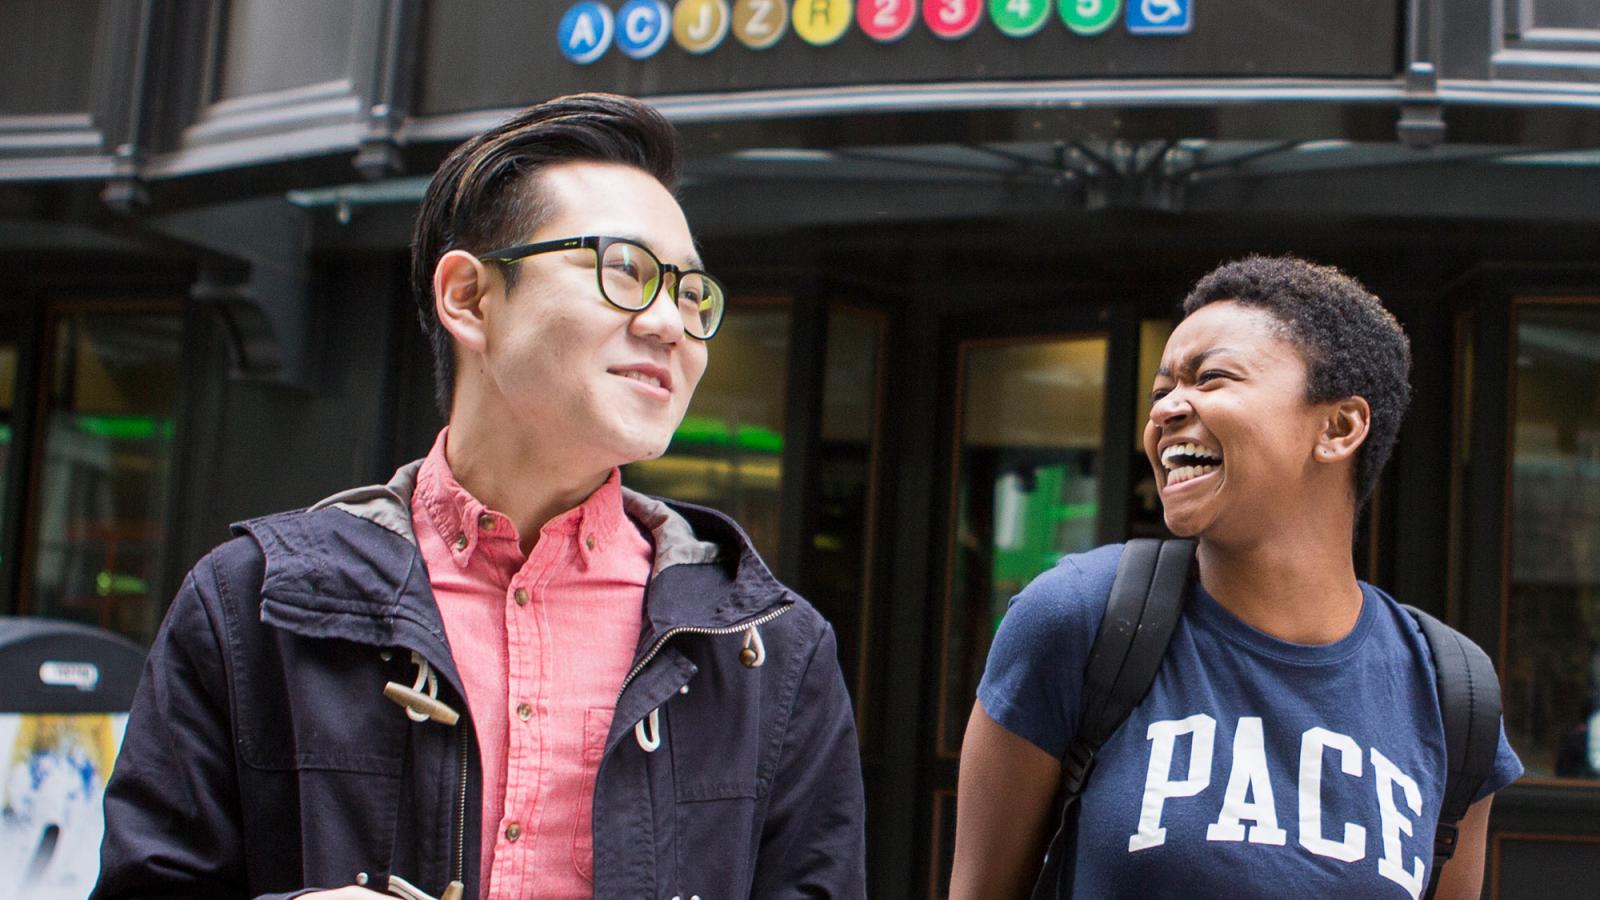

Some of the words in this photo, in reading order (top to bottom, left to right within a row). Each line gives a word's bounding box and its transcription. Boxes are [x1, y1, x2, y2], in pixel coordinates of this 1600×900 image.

[568, 12, 597, 48] A
[625, 6, 654, 43] C
[687, 3, 713, 40] J
[745, 0, 773, 34] Z
[873, 0, 898, 26] 2
[938, 0, 965, 24] 3
[1128, 713, 1425, 900] PACE
